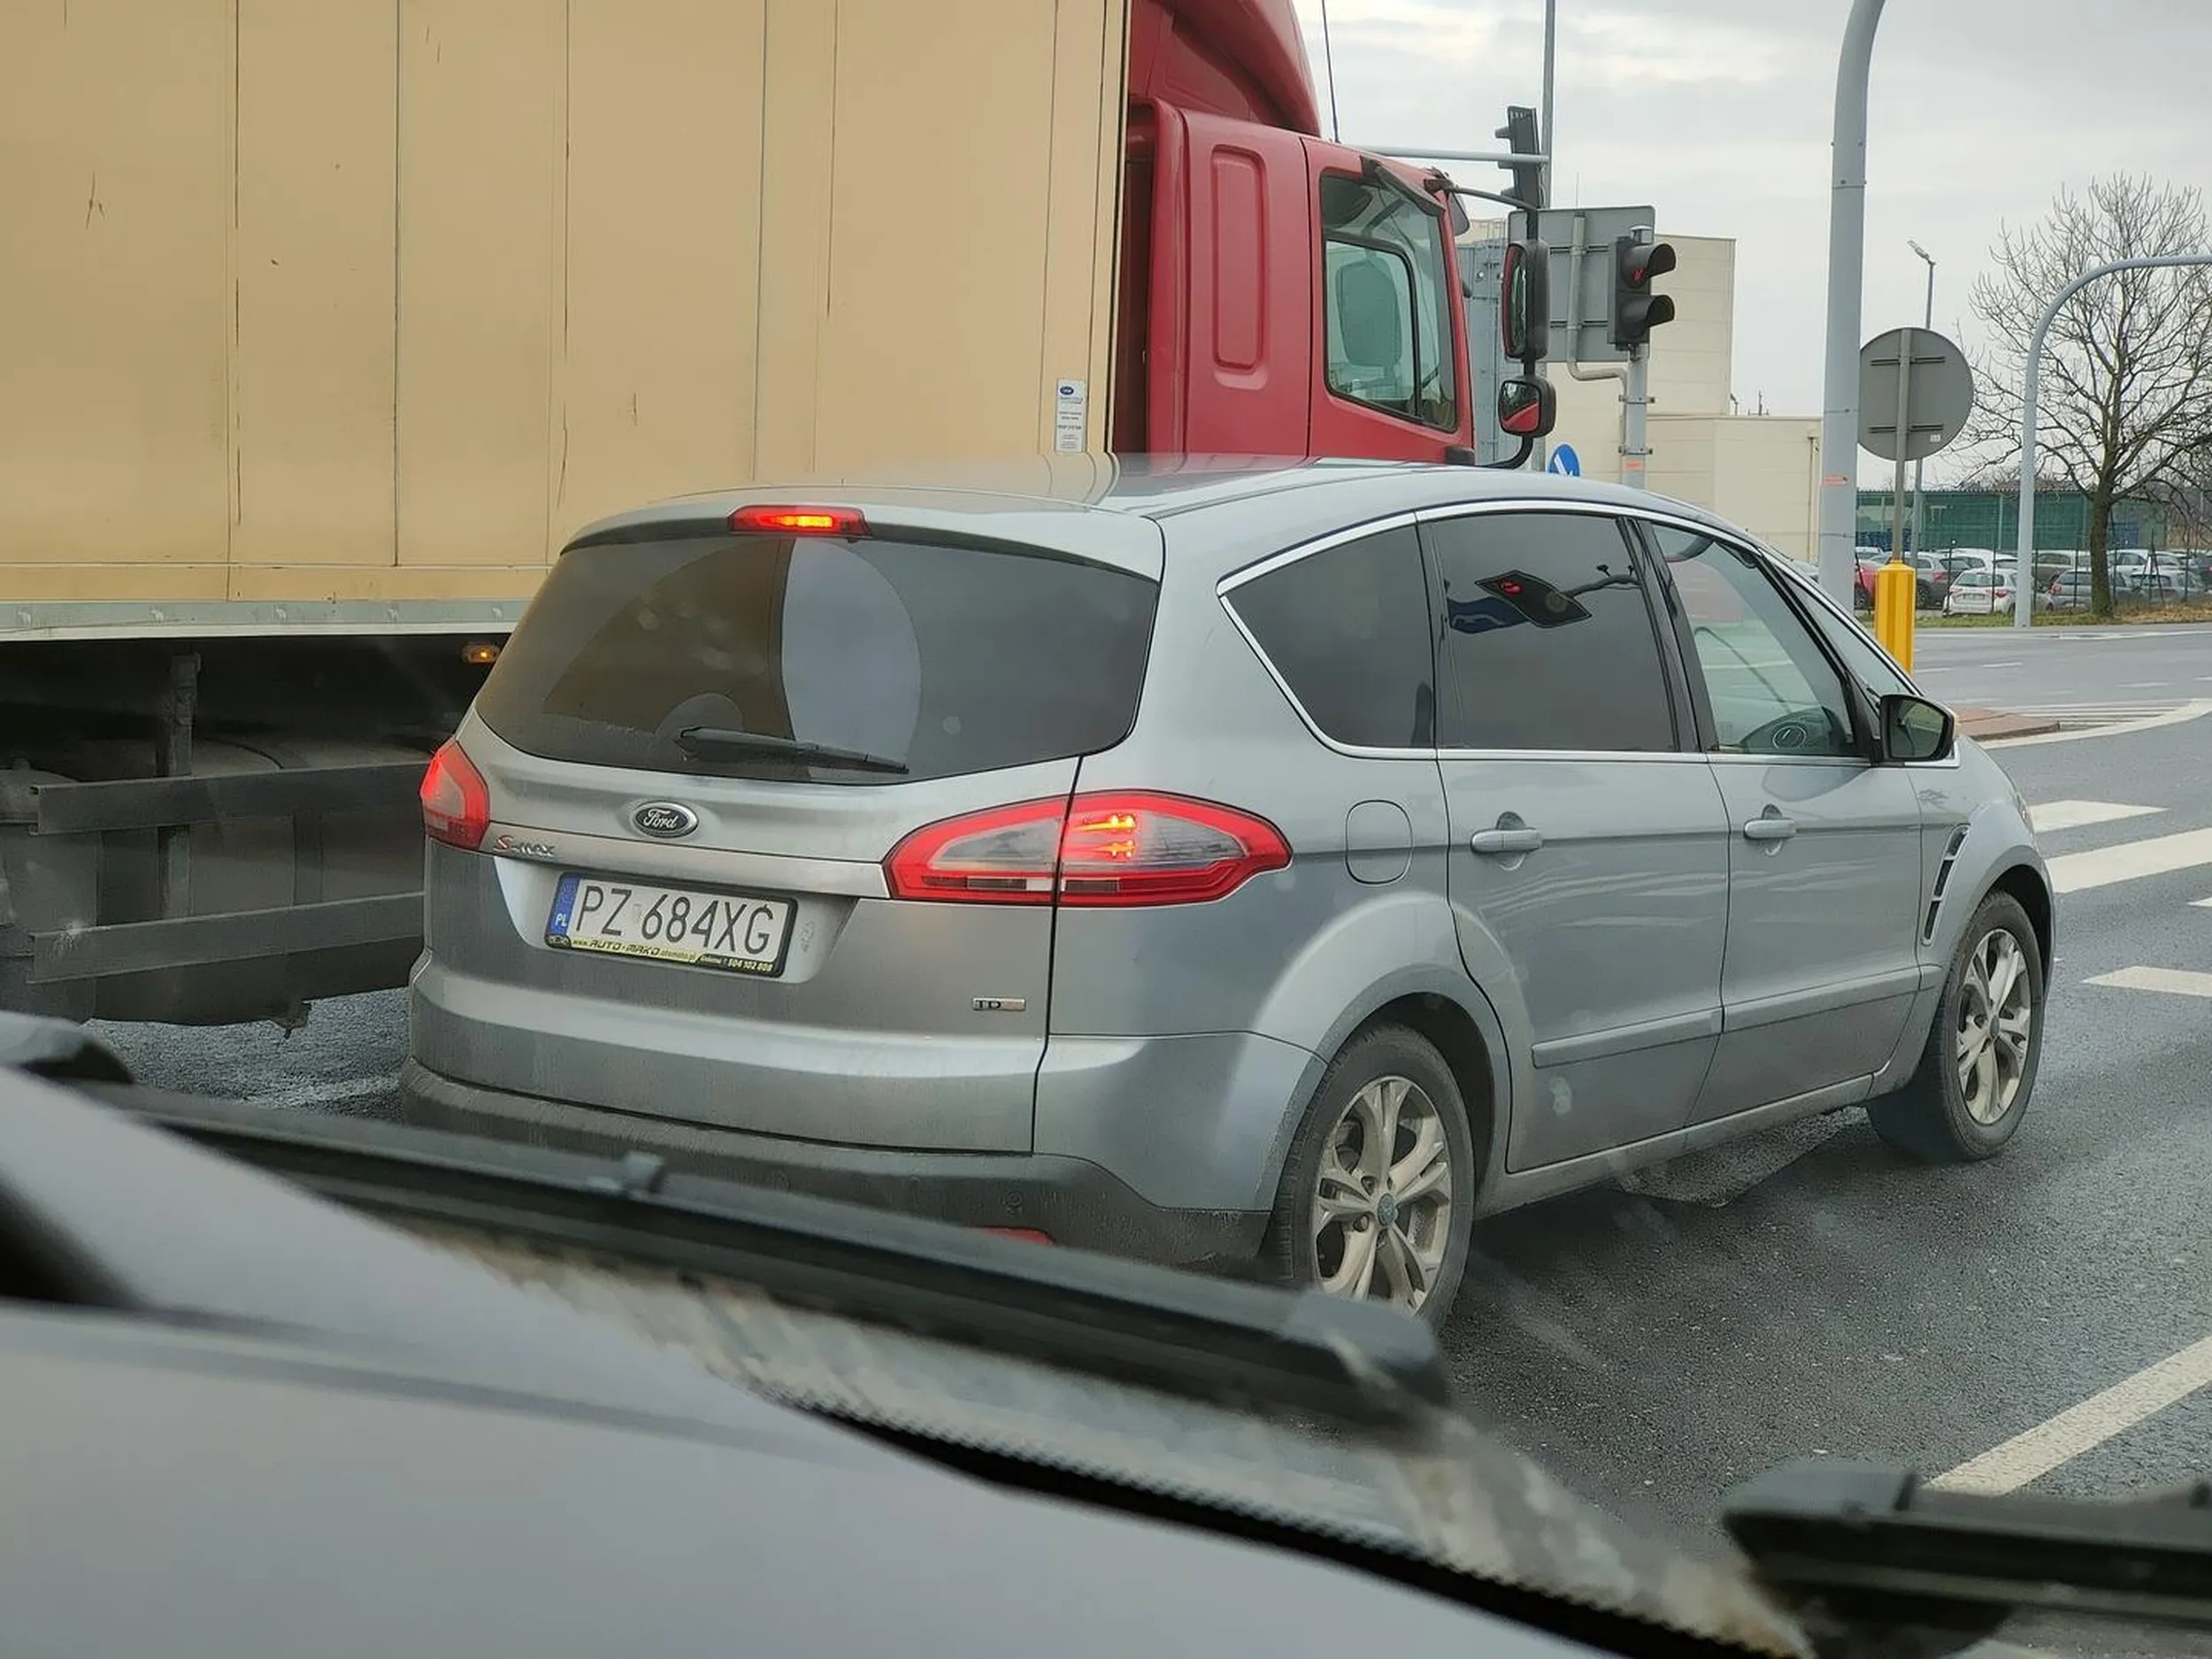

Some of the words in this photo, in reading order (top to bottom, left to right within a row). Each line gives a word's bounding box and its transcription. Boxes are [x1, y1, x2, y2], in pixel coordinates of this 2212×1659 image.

[642, 807, 680, 830] Ford
[554, 912, 568, 928] PL
[575, 884, 633, 937] PZ
[640, 893, 775, 956] 684XG
